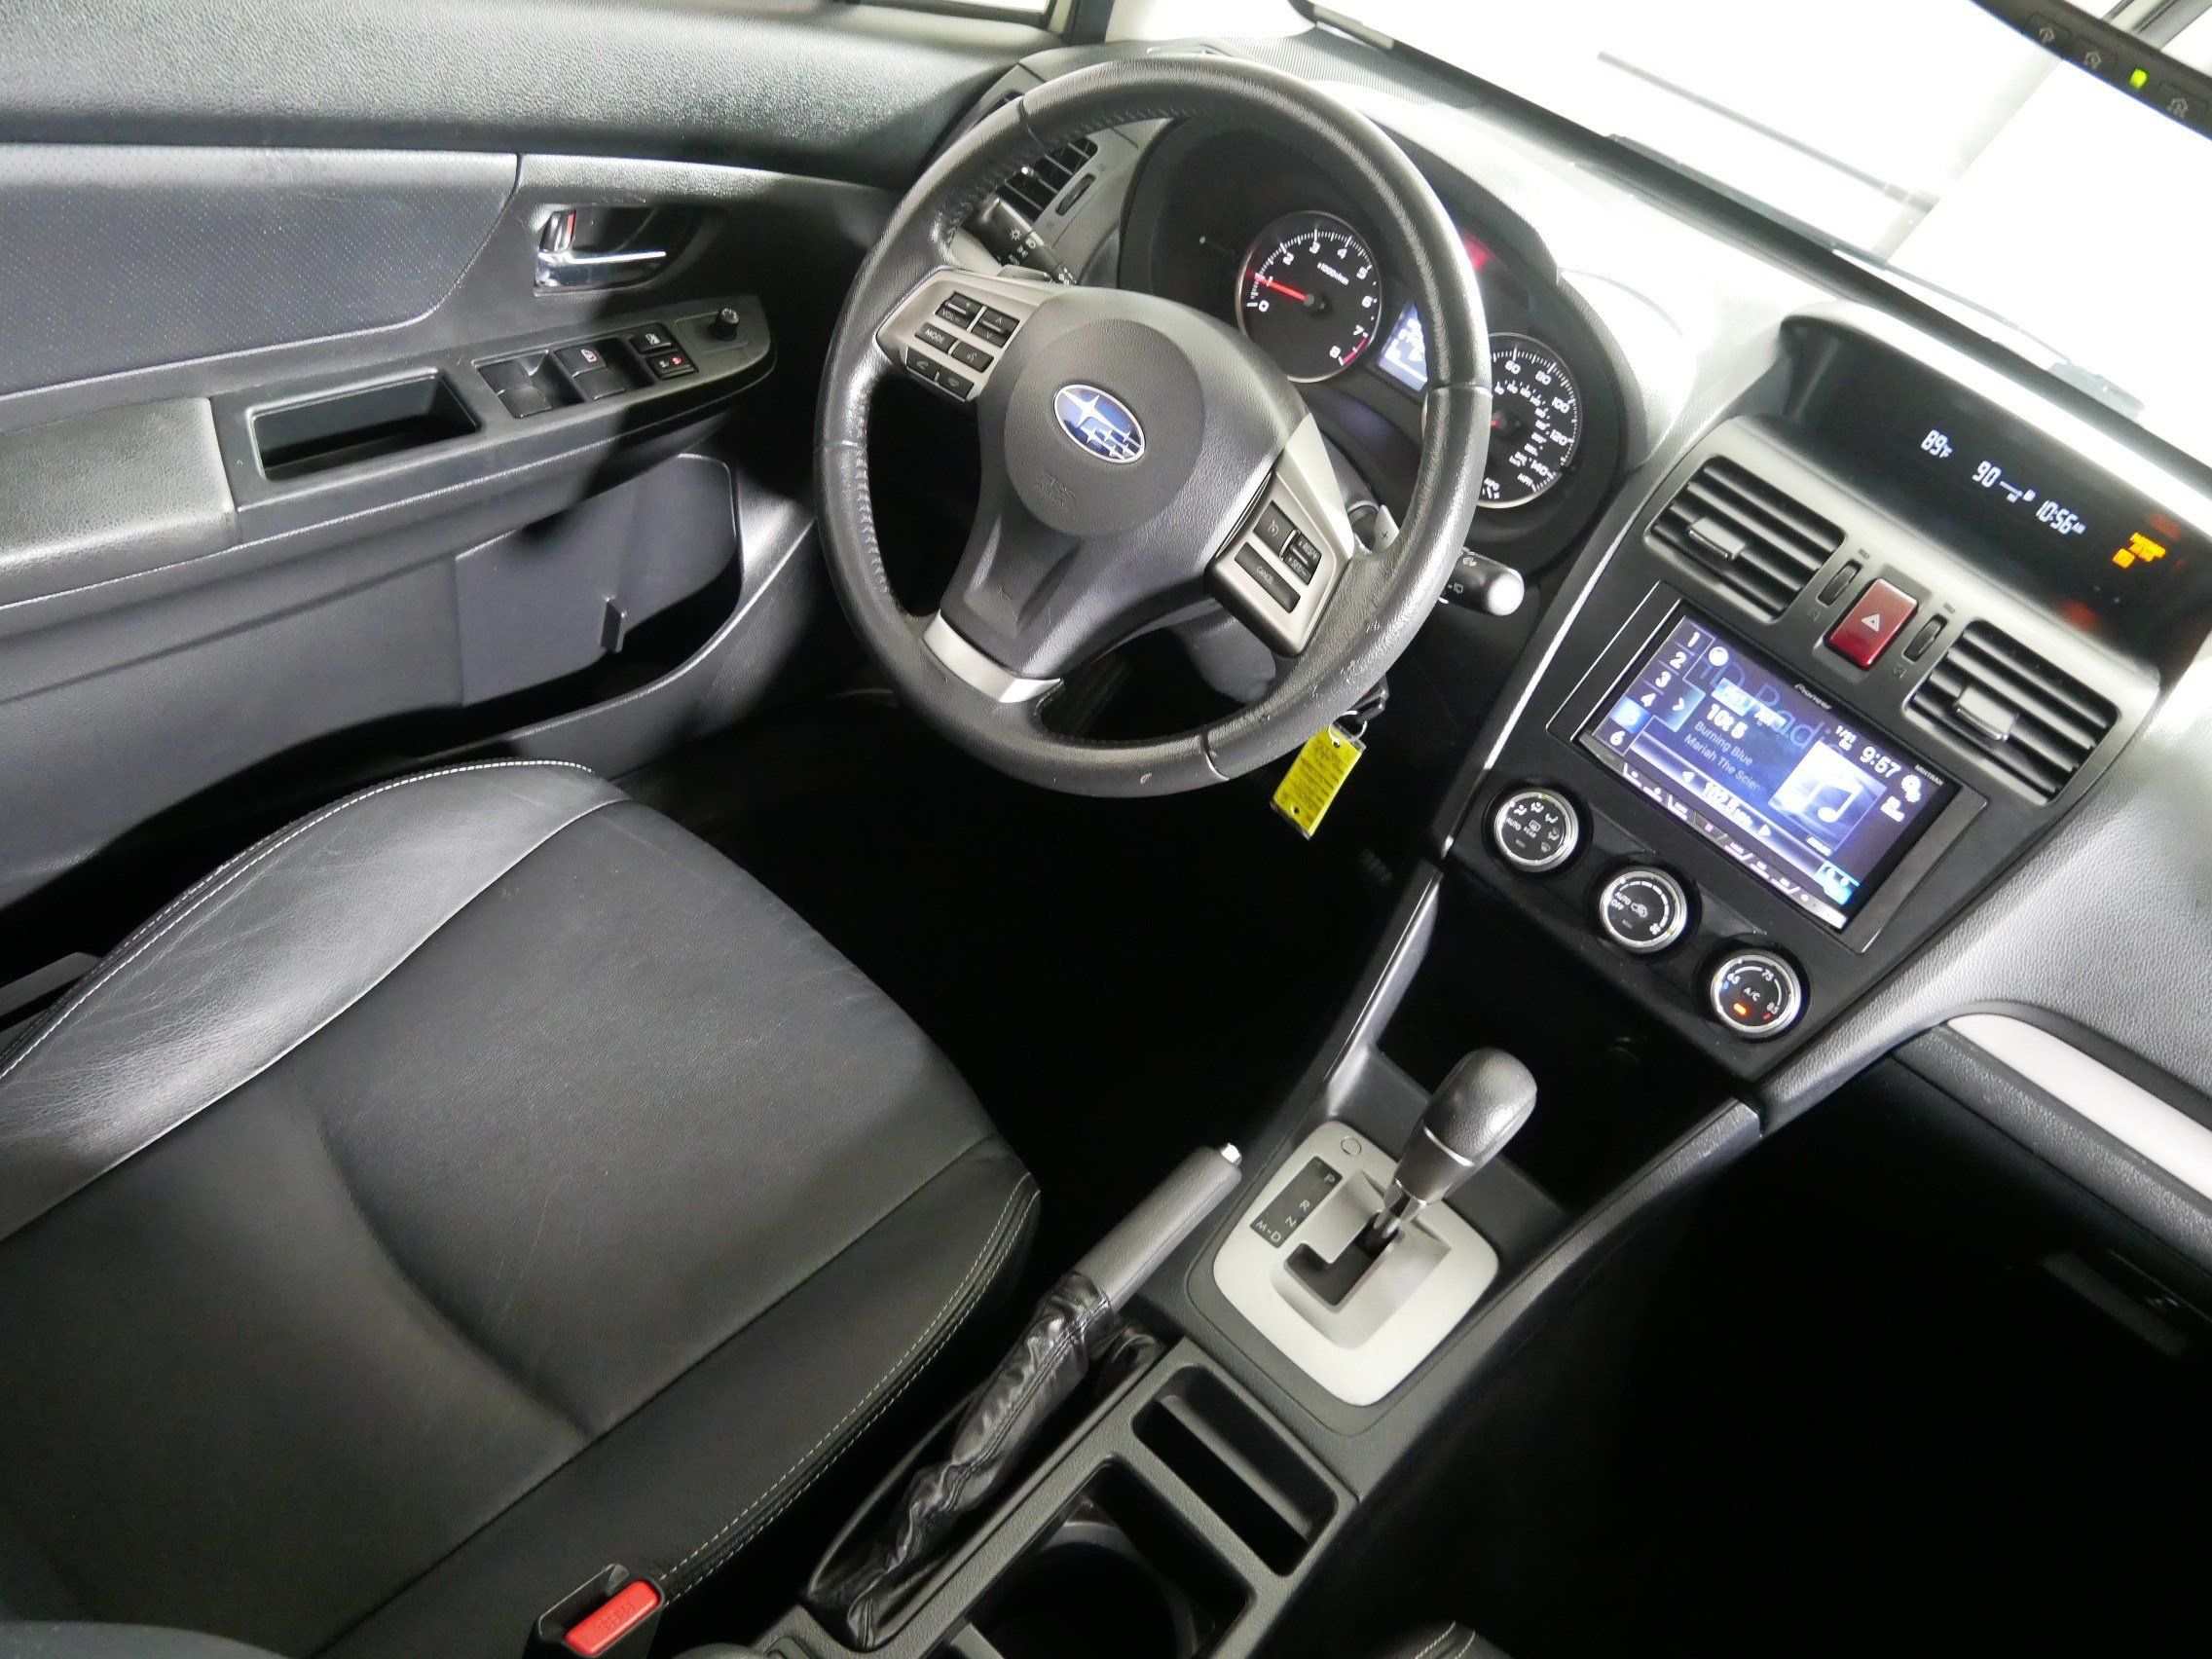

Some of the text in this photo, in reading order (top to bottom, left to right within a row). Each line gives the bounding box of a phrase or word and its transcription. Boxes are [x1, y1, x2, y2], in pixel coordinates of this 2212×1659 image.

[1309, 240, 1321, 254] 3
[1337, 247, 1347, 260] 4
[1282, 252, 1295, 266] 2
[1356, 266, 1369, 280] 5
[1258, 299, 1270, 313] 0
[1362, 295, 1374, 309] 6
[1352, 324, 1365, 336] 7
[1329, 345, 1342, 359] 8
[1534, 370, 1552, 386] 80
[1551, 396, 1570, 414] 100
[1530, 460, 1549, 476] 140
[1972, 461, 2002, 488] 90
[2036, 499, 2079, 535] 10:56
[1687, 631, 1700, 648] 1
[1669, 650, 1687, 670] 2
[1655, 670, 1672, 688] 3
[1641, 692, 1656, 708] 4
[1793, 682, 1832, 711] Pioneer
[1609, 730, 1626, 746] 6
[1694, 720, 1753, 767] Burning Blue
[1683, 733, 1717, 762] Mariah
[1717, 756, 1736, 775] The
[1860, 746, 1901, 778] 9:57
[1610, 898, 1625, 911] OFF
[1615, 891, 1632, 905] AUTO
[1726, 973, 1741, 984] 65
[1743, 986, 1761, 1002] A/C
[1323, 1173, 1336, 1184] P
[1299, 1199, 1310, 1212] R
[1284, 1215, 1297, 1228] N
